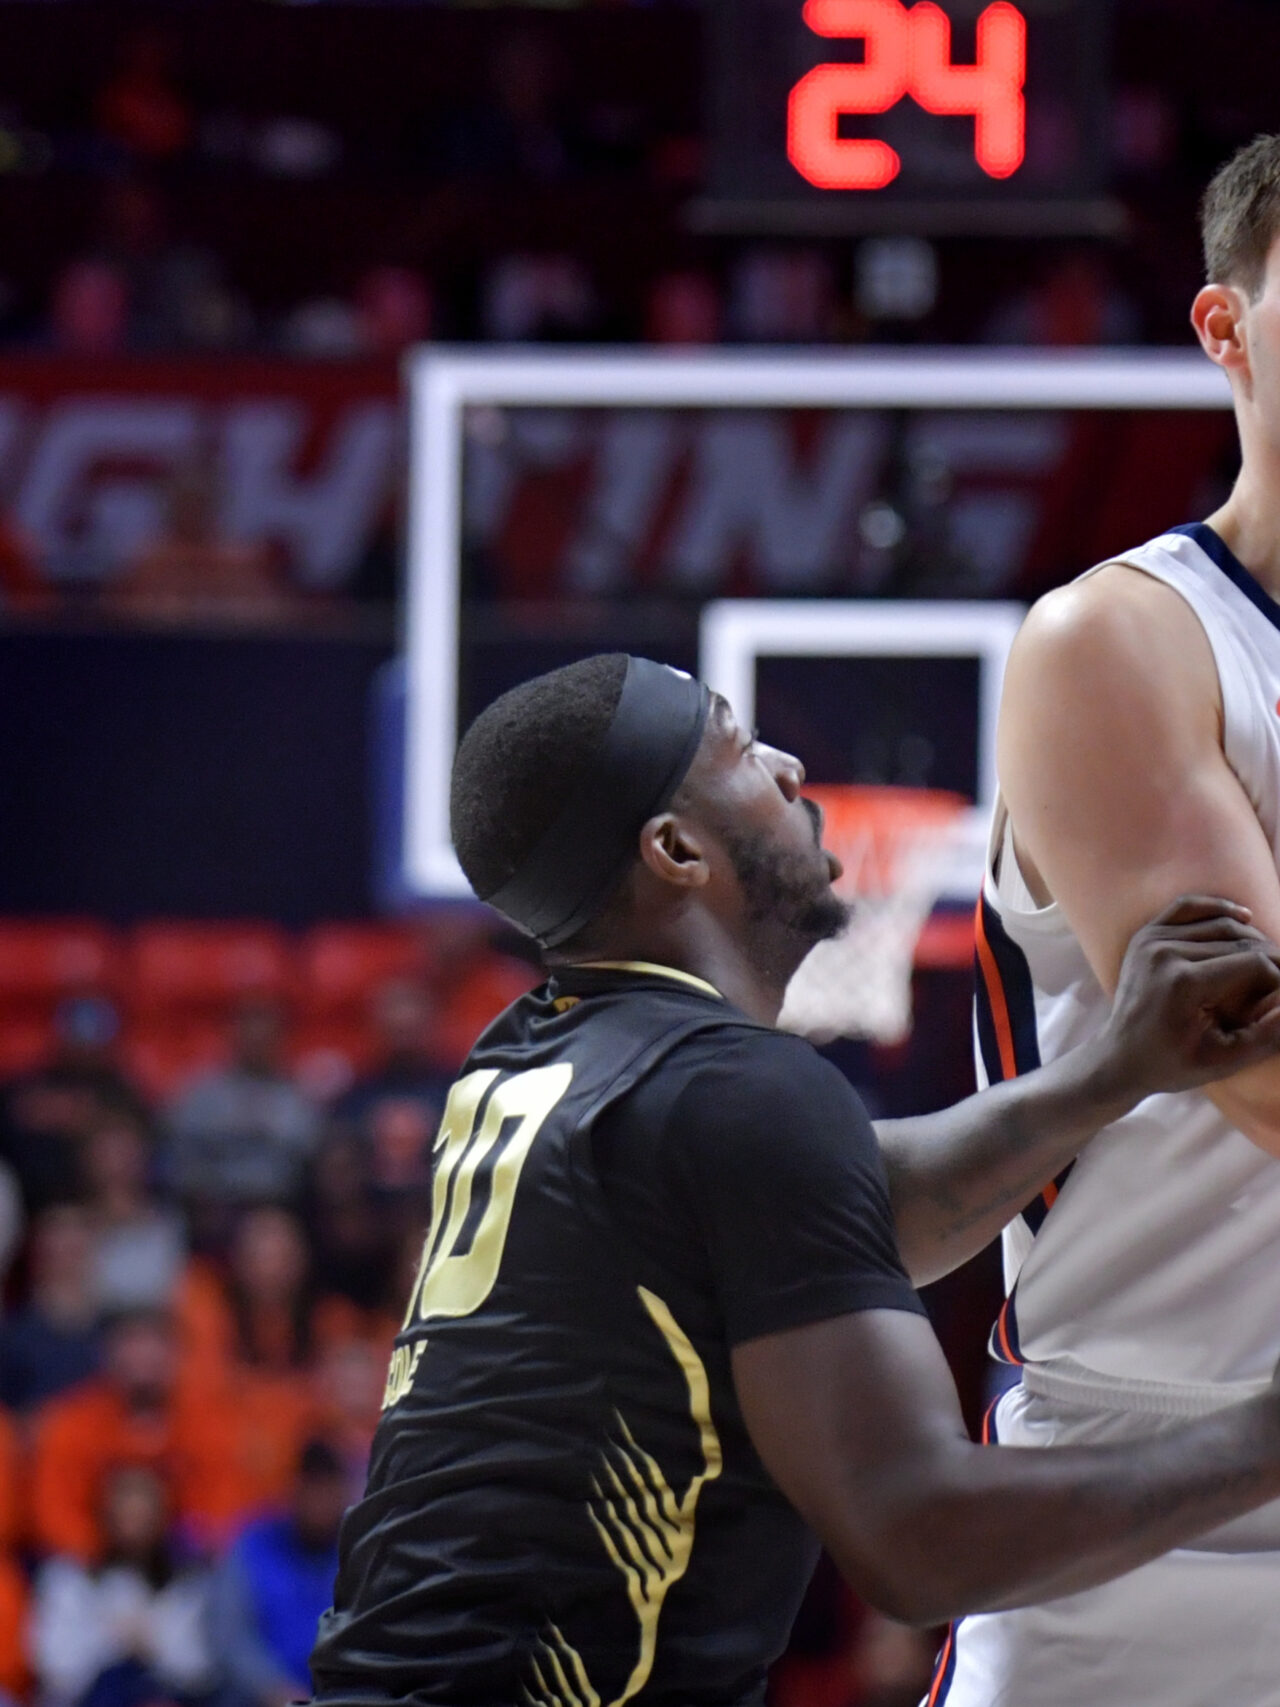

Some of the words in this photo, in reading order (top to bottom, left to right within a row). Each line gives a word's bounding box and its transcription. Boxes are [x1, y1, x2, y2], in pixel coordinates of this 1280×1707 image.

[787, 0, 1026, 189] 24
[0, 398, 1072, 588] GHTING
[402, 1062, 574, 1331] 10
